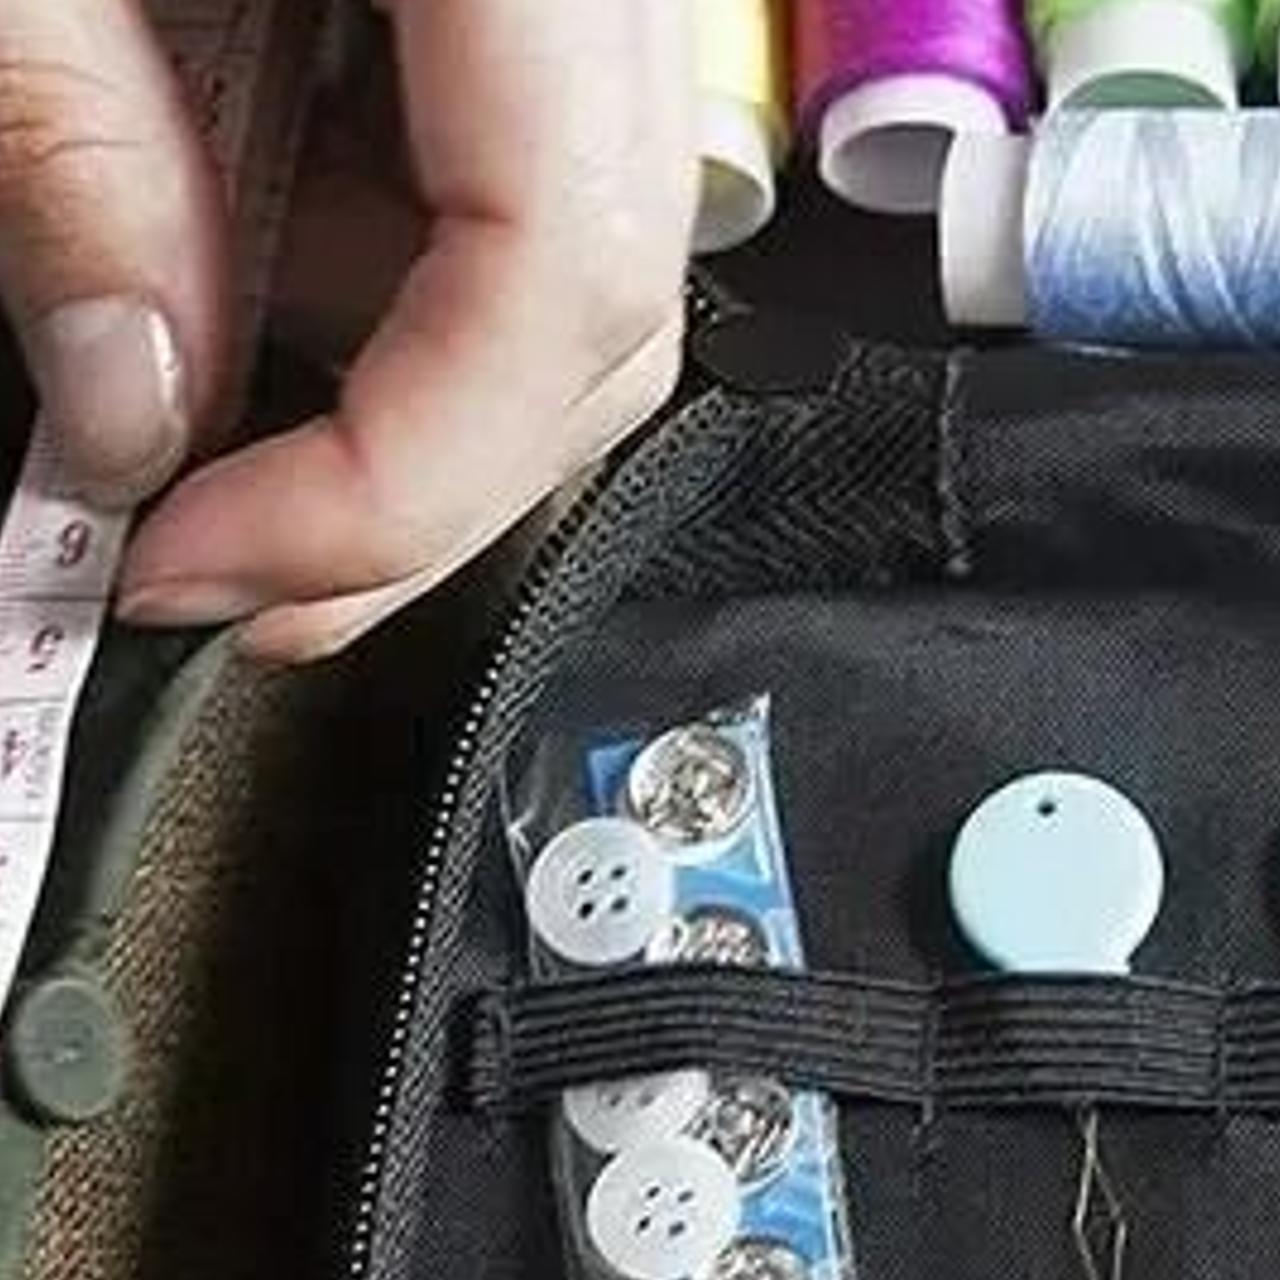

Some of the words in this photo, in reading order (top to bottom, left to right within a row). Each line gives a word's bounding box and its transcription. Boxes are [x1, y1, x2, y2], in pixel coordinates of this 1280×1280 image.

[55, 521, 93, 568] 6
[28, 624, 66, 673] 5
[0, 728, 27, 779] 4
